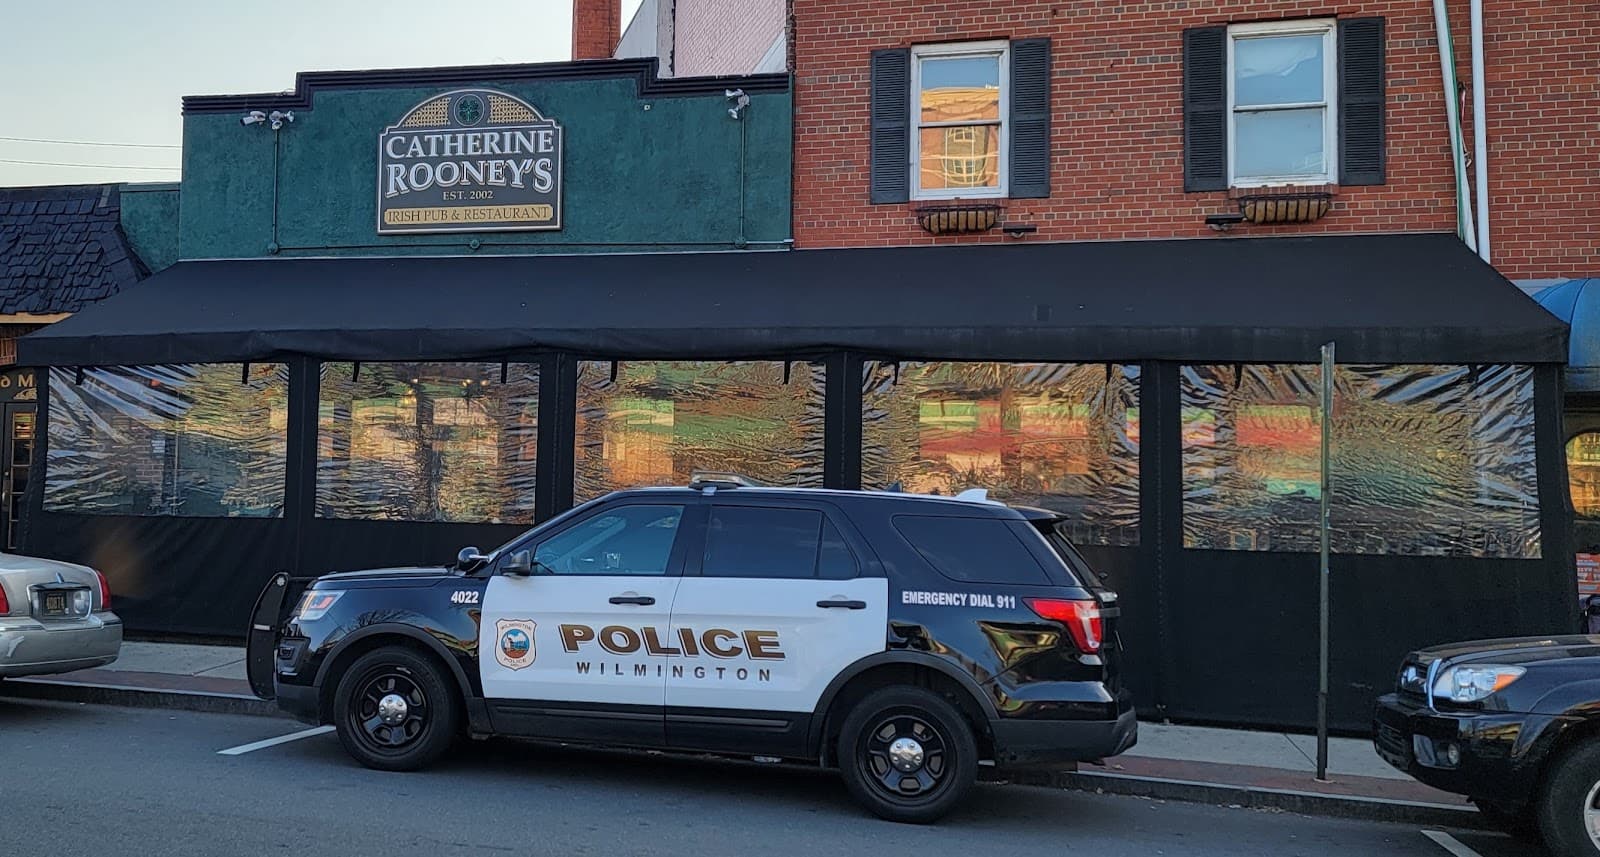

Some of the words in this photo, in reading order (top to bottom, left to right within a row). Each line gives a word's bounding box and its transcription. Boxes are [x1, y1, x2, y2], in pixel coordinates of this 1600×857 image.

[386, 130, 554, 158] CATHERINE
[385, 158, 554, 199] ROONEY'S
[443, 191, 467, 200] EST.
[470, 190, 494, 200] 2002
[388, 210, 421, 223] IRISH
[424, 209, 448, 221] PUB
[450, 209, 460, 221] &
[464, 206, 550, 220] RESTAURANT
[450, 590, 479, 604] 4022
[902, 591, 967, 606] EMERGENCY
[969, 594, 995, 608] DIAL
[996, 595, 1016, 609] 911
[557, 623, 787, 661] POLICE
[576, 661, 771, 682] WILMINGTON
